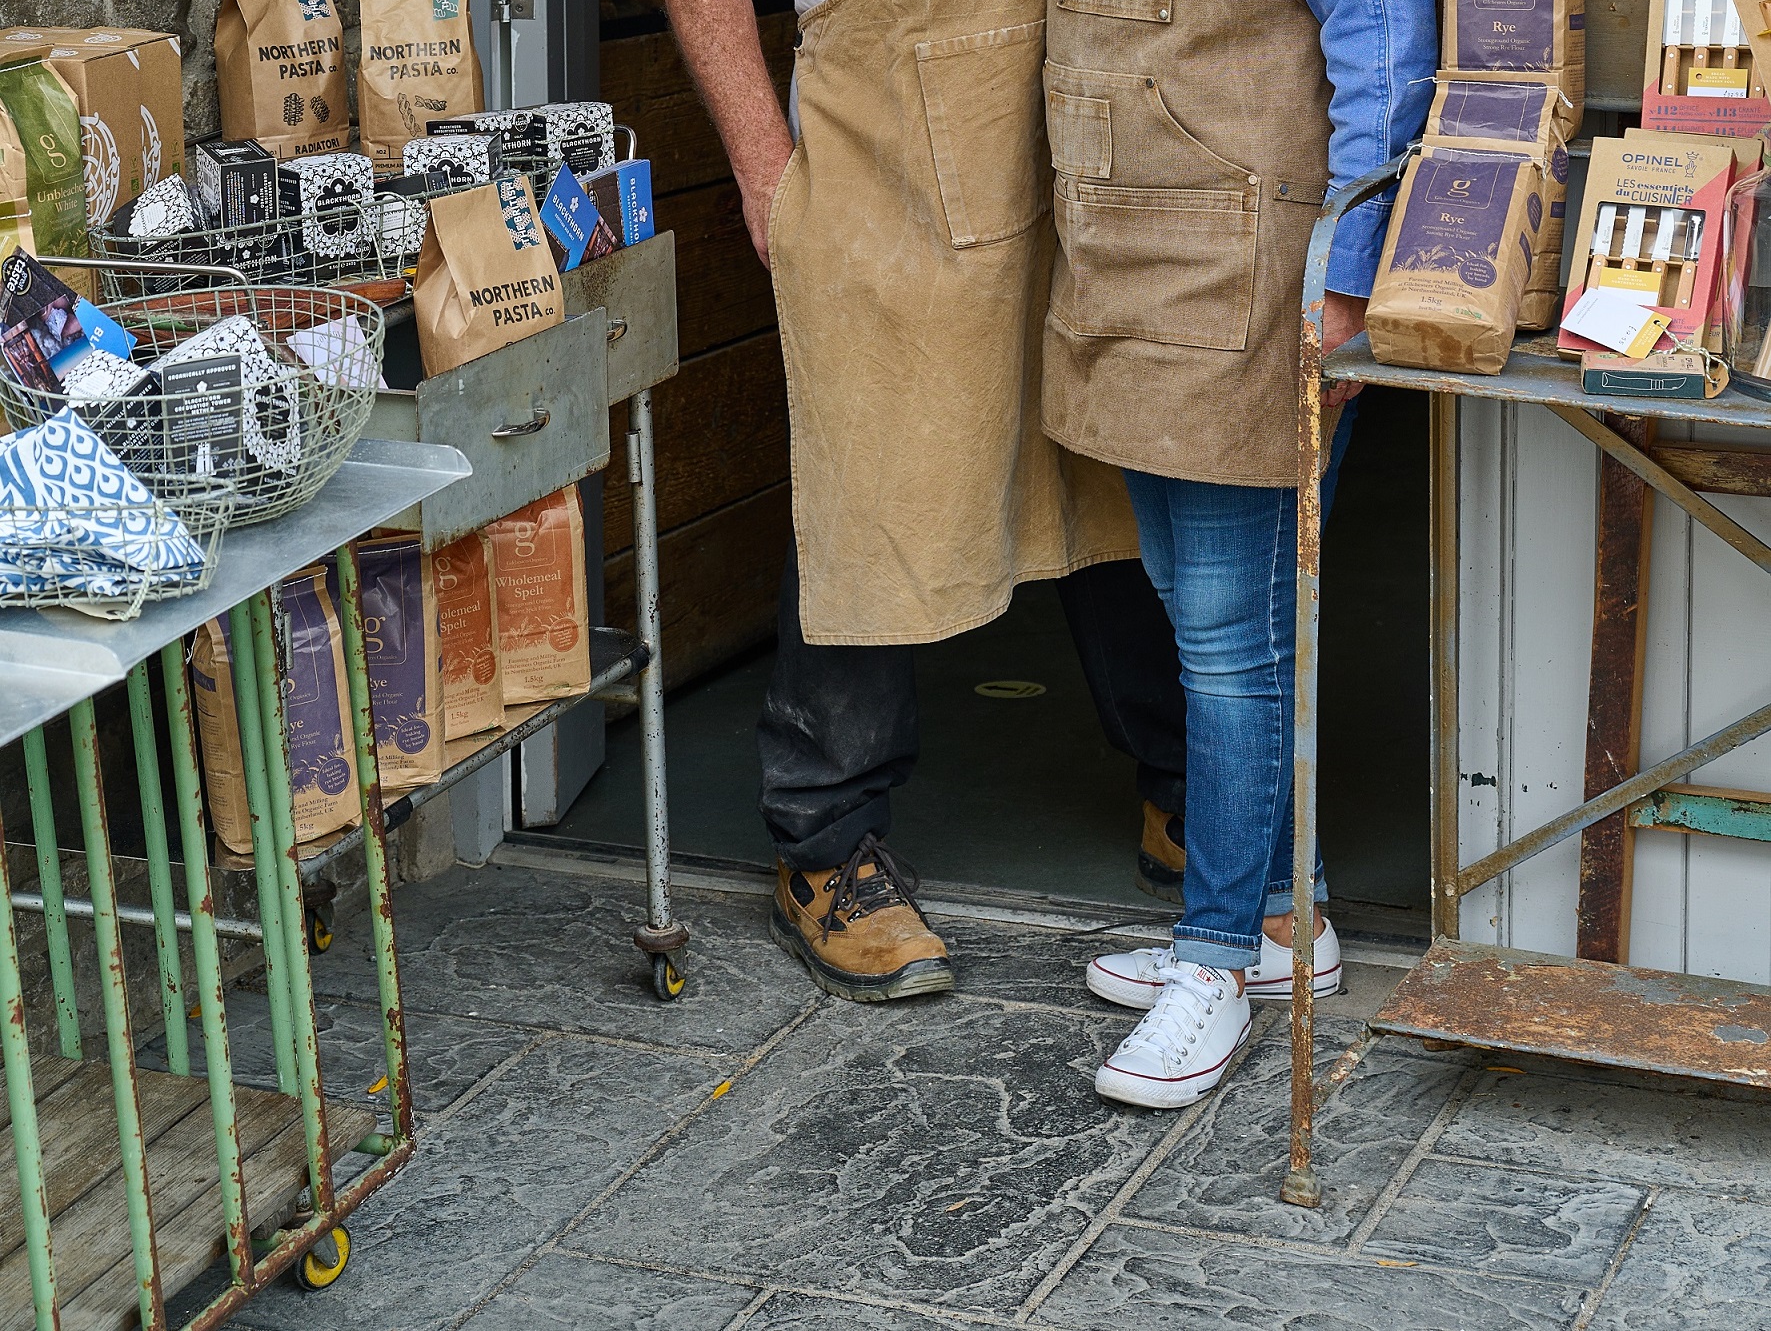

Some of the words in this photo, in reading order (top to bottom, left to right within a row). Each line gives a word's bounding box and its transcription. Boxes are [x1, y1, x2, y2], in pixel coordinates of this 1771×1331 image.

[308, 0, 320, 16] THE
[1493, 21, 1516, 35] Rye
[258, 36, 340, 61] NORTHERN
[370, 39, 461, 61] NORTHERN
[278, 60, 326, 80] PASTA
[390, 62, 443, 80] PASTA
[295, 138, 340, 155] RADIATORI
[502, 139, 531, 150] KTHORN
[562, 137, 601, 148] BLACKTHORN
[39, 134, 66, 168] g
[1622, 153, 1683, 168] OPINEL
[451, 175, 472, 184] HORN
[1447, 178, 1477, 197] g
[1617, 179, 1635, 188] LES
[1637, 183, 1694, 194] essentiels
[318, 193, 360, 206] BLACKTHORN
[506, 182, 521, 224] BRITISH
[1615, 189, 1630, 197] du
[1631, 190, 1692, 205] CUISINIER
[55, 199, 77, 212] White
[630, 177, 640, 243] BLACKTHO
[552, 194, 585, 241] BLACKTHORN
[1440, 213, 1465, 225] Rye
[516, 225, 530, 244] THE
[7, 260, 25, 291] taste
[470, 274, 555, 307] NORTHERN
[1421, 296, 1442, 306] 1.5kg
[494, 302, 542, 326] PASTA
[168, 370, 205, 381] ORGANICALLY
[206, 364, 236, 374] APPROVED
[211, 398, 231, 406] TOWER
[514, 522, 535, 557] g
[435, 556, 457, 590] g
[495, 570, 561, 587] Wholemeal
[515, 586, 544, 600] Spelt
[441, 600, 481, 619] olemeal
[440, 619, 467, 633] Spelt
[290, 719, 304, 733] ye
[300, 731, 320, 739] Organic
[326, 769, 342, 778] baking
[332, 773, 346, 782] breads
[301, 804, 323, 813] Organic
[309, 797, 328, 805] Milling
